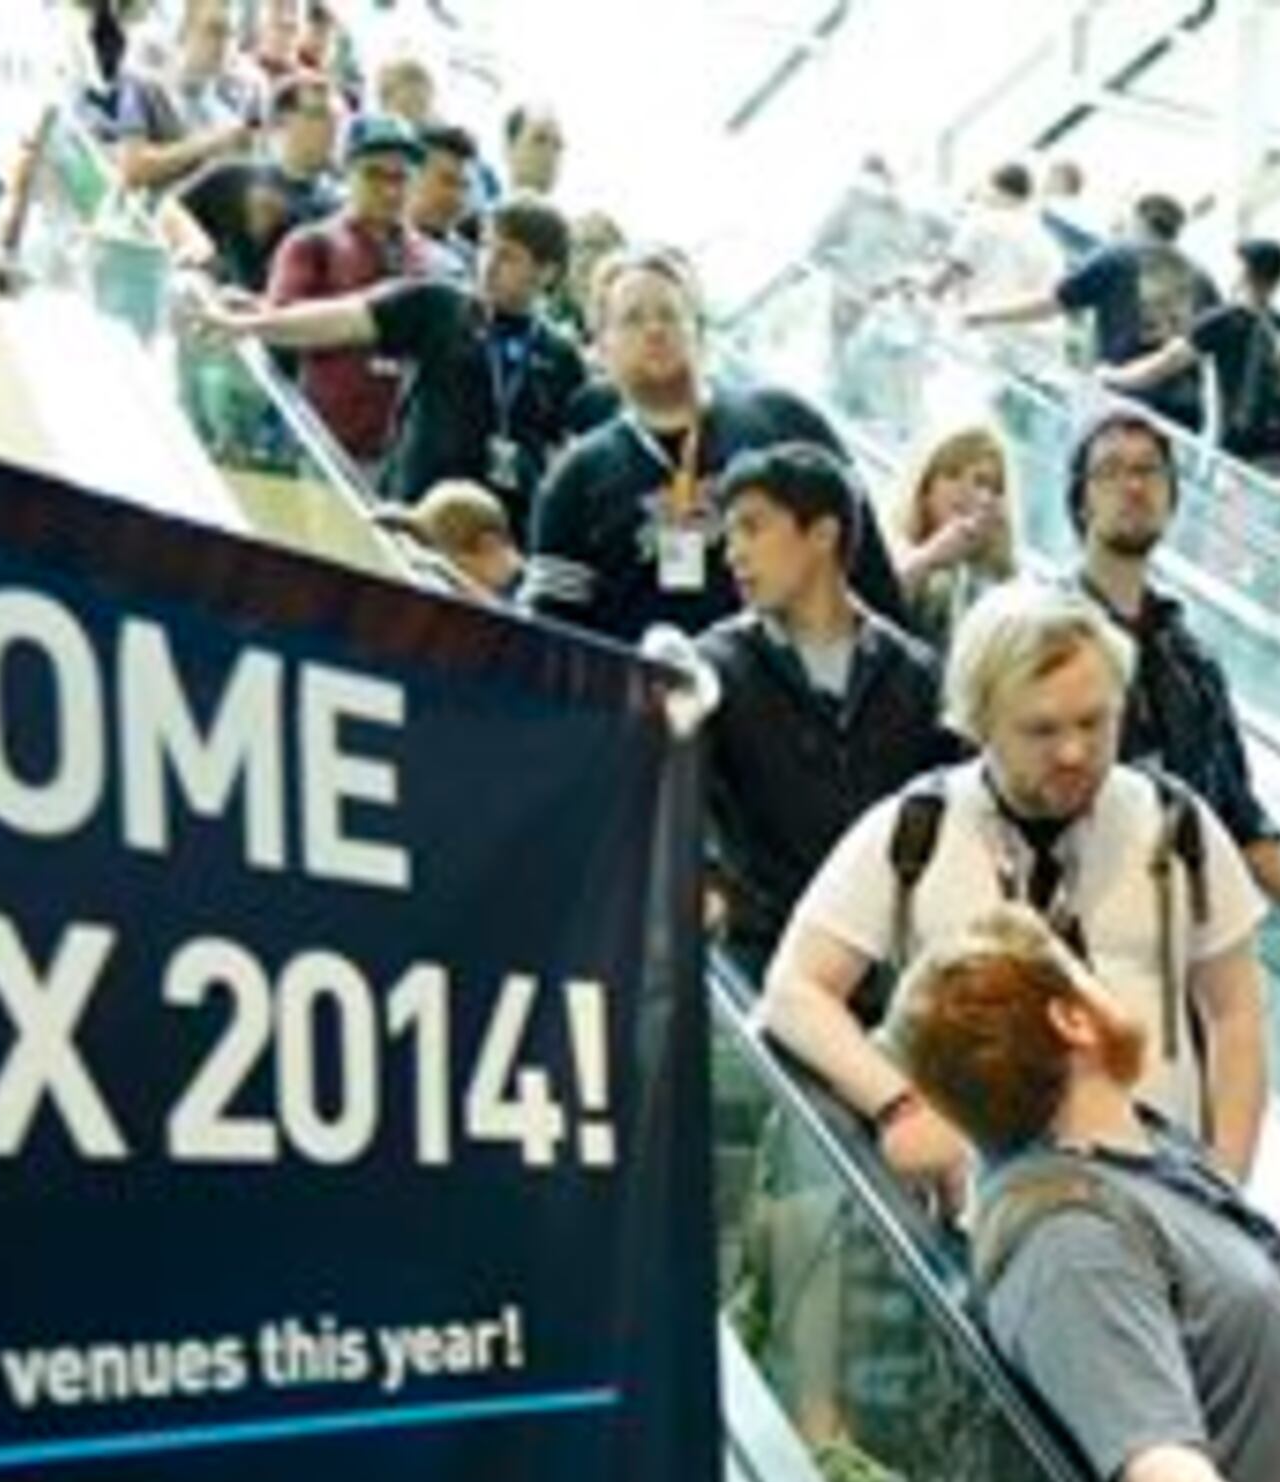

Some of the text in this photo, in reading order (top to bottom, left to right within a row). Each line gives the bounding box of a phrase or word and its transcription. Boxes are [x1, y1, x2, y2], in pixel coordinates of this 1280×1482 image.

[165, 942, 619, 1170] 2014!
[1, 1334, 246, 1408] venues
[257, 1316, 368, 1382] this
[377, 1306, 525, 1393] year!
